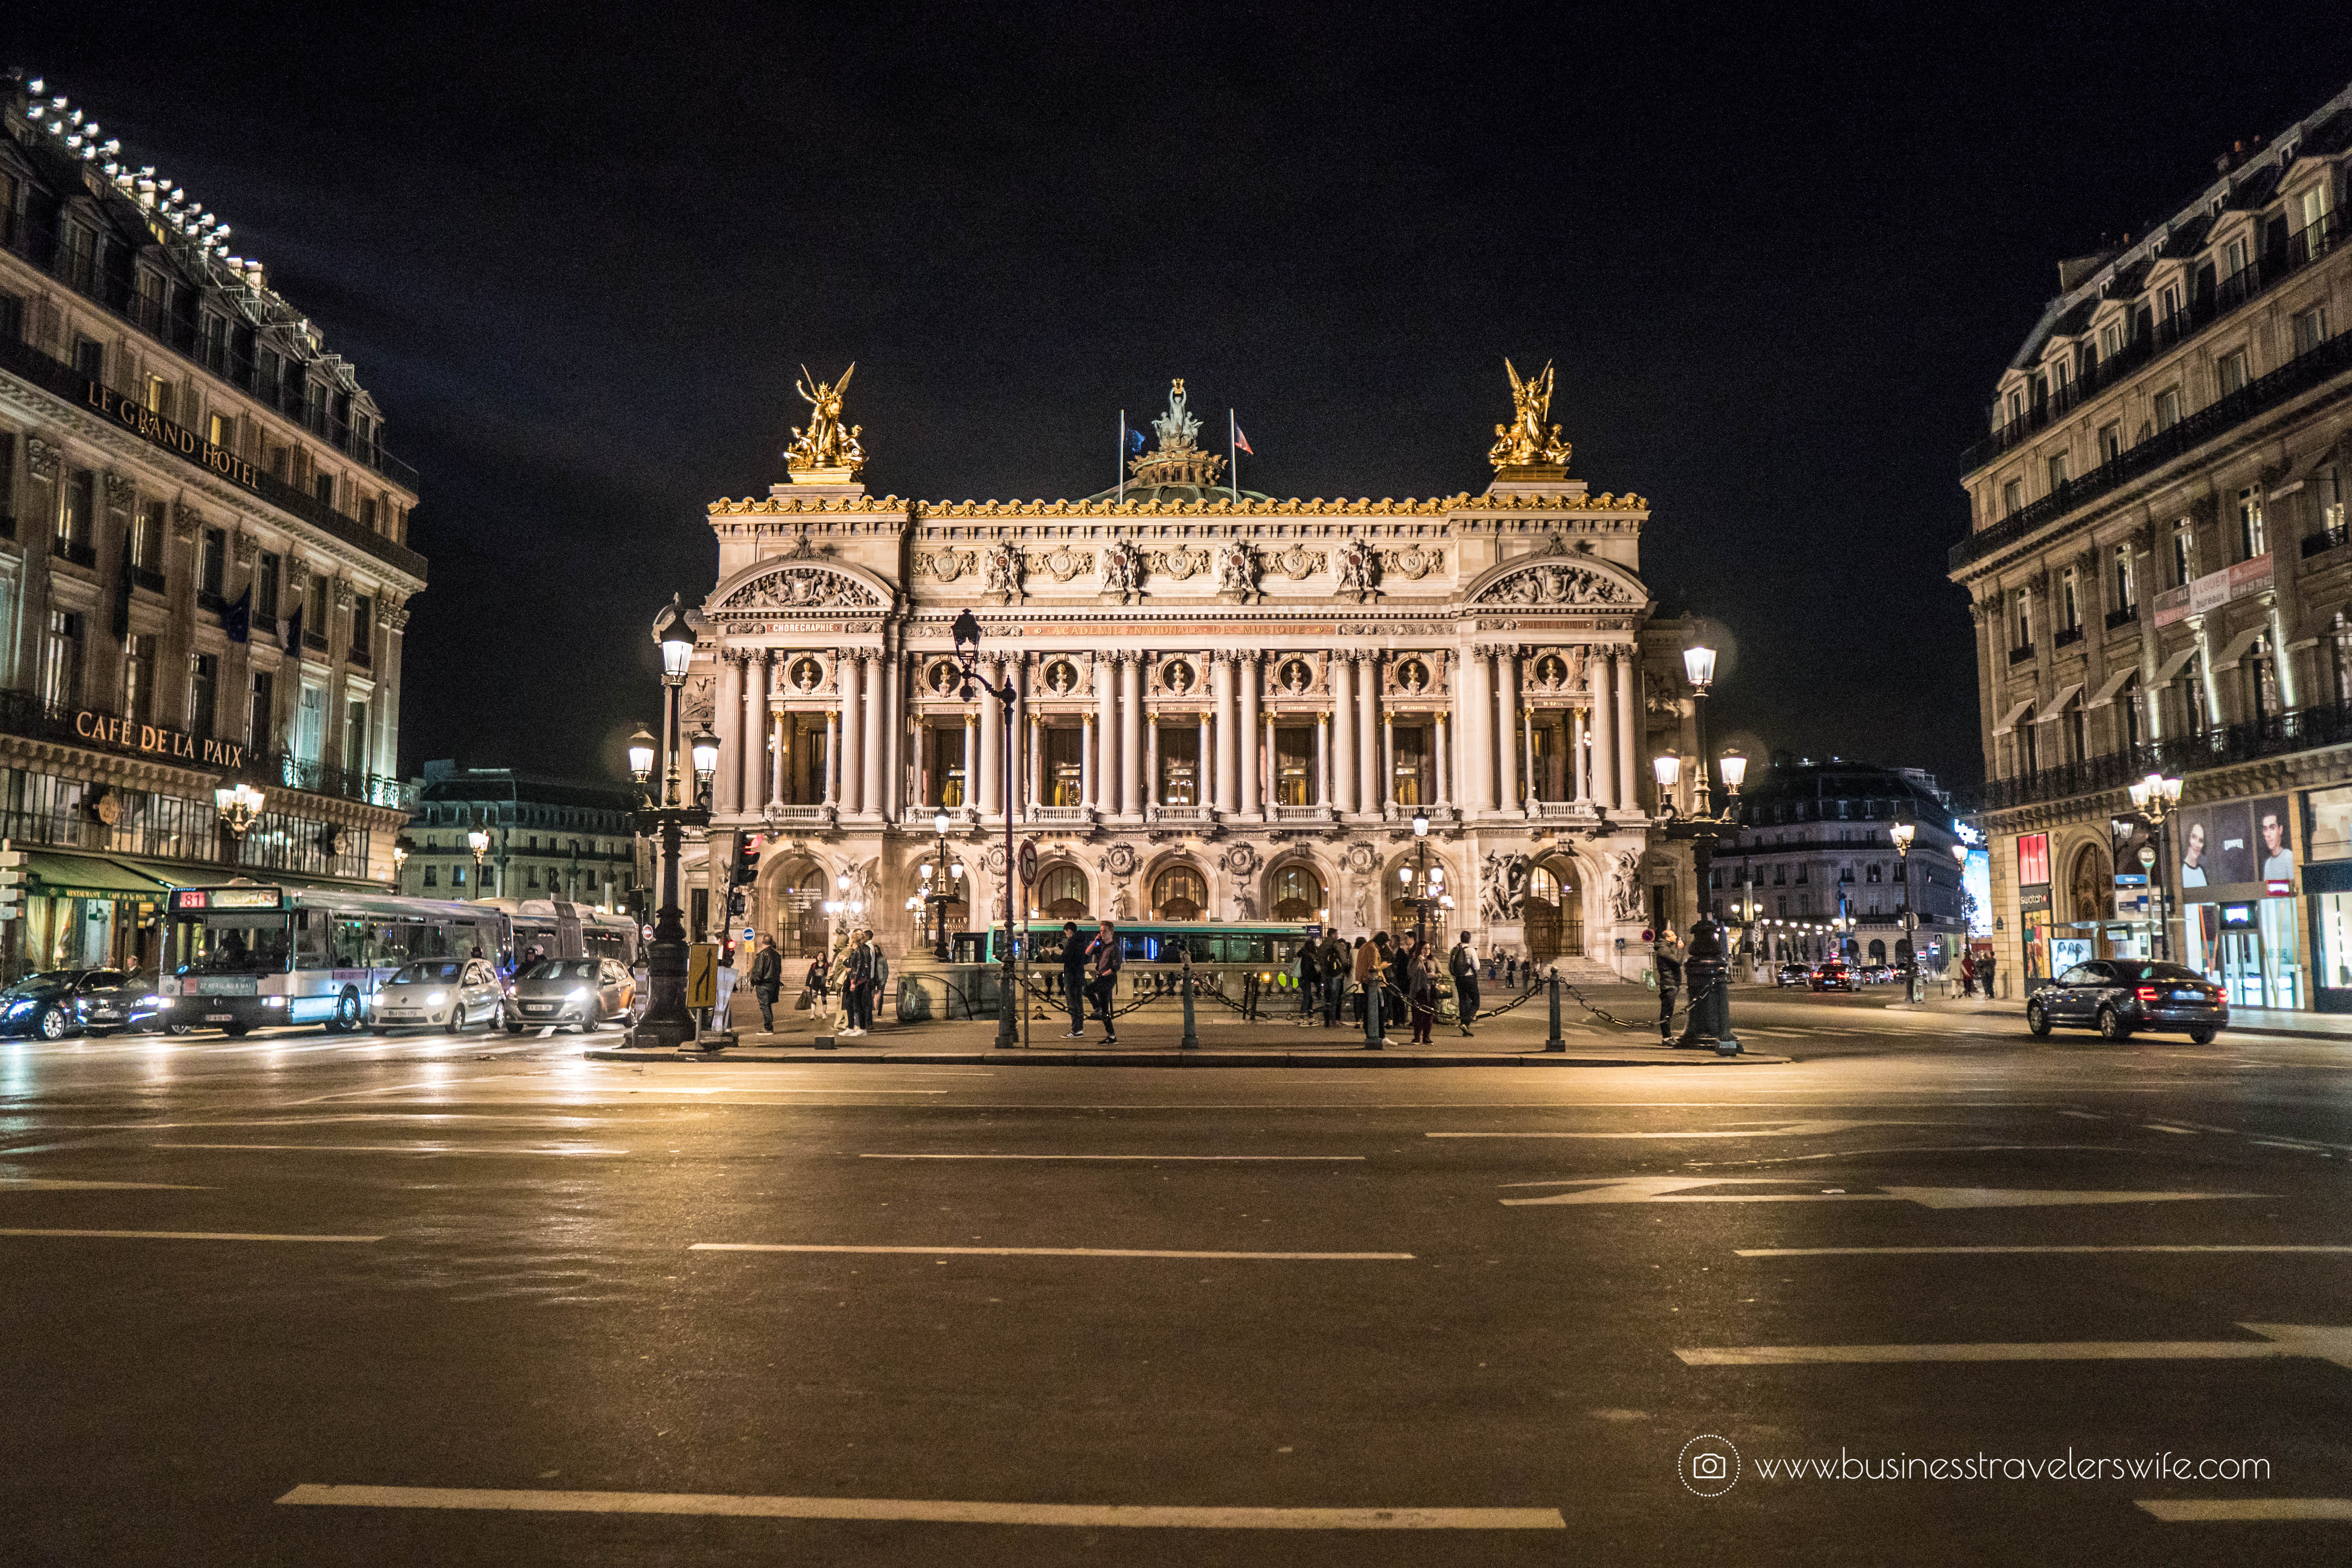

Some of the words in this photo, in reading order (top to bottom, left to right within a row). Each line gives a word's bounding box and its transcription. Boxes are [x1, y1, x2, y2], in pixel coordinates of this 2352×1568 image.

[89, 381, 111, 413] LE
[120, 399, 194, 454] GRAND
[203, 442, 259, 490] HOTEL
[773, 624, 834, 632] CHOREGRAPHIE
[1053, 626, 1123, 635] ACADEMIE
[1134, 626, 1201, 635] NATIONALE
[1214, 626, 1231, 634] DE
[1243, 625, 1305, 634] MUSIQUE
[140, 724, 167, 753] DE
[174, 733, 194, 759] LA
[204, 739, 242, 768] PAIX
[185, 894, 200, 907] 81
[2020, 894, 2042, 905] swatch
